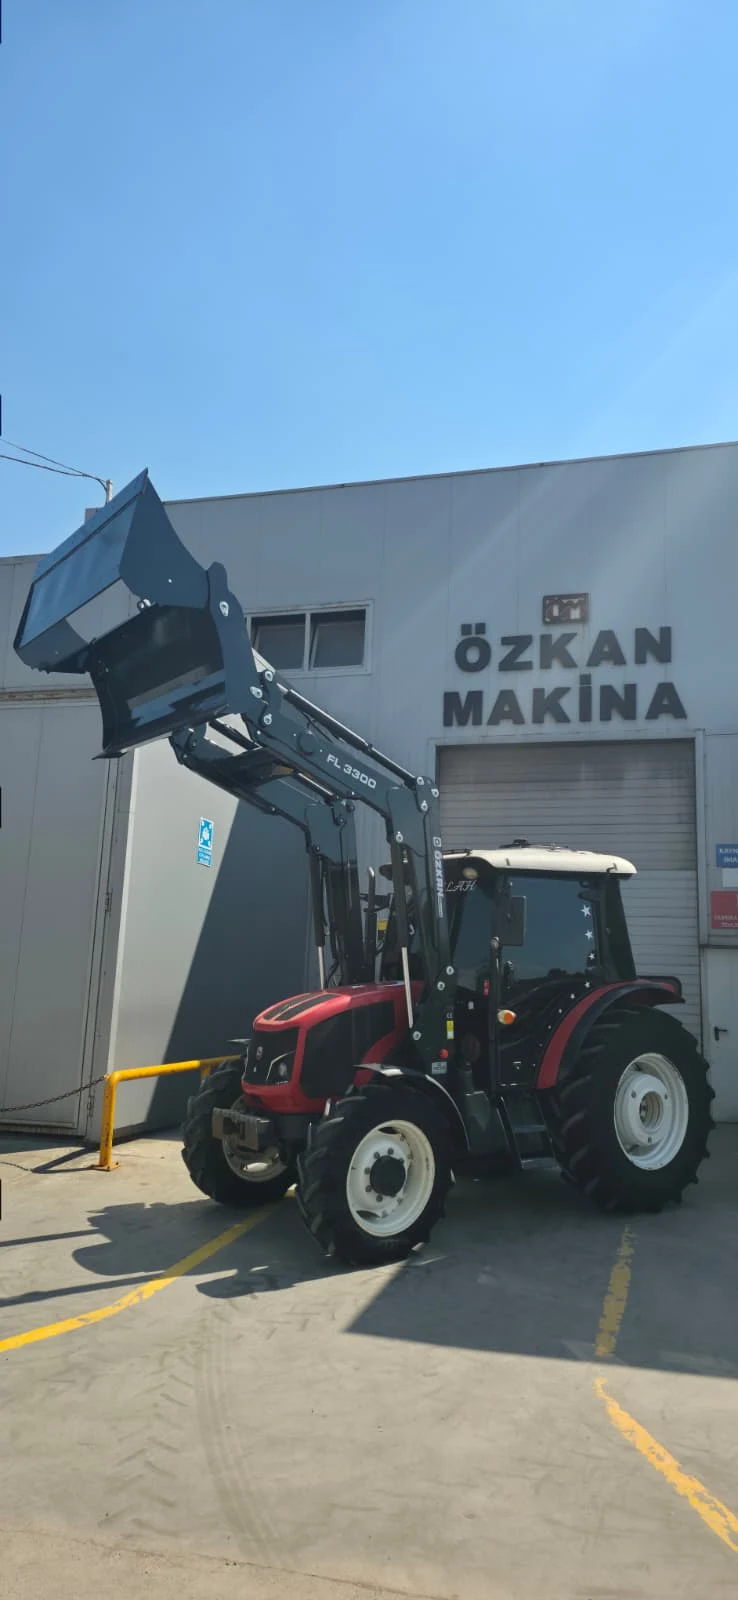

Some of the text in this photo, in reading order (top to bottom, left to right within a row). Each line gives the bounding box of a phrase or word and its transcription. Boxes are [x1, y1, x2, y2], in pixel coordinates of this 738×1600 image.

[454, 622, 672, 673] ÖZKAN
[442, 673, 688, 727] MAKİNA
[326, 753, 377, 789] FL 3300
